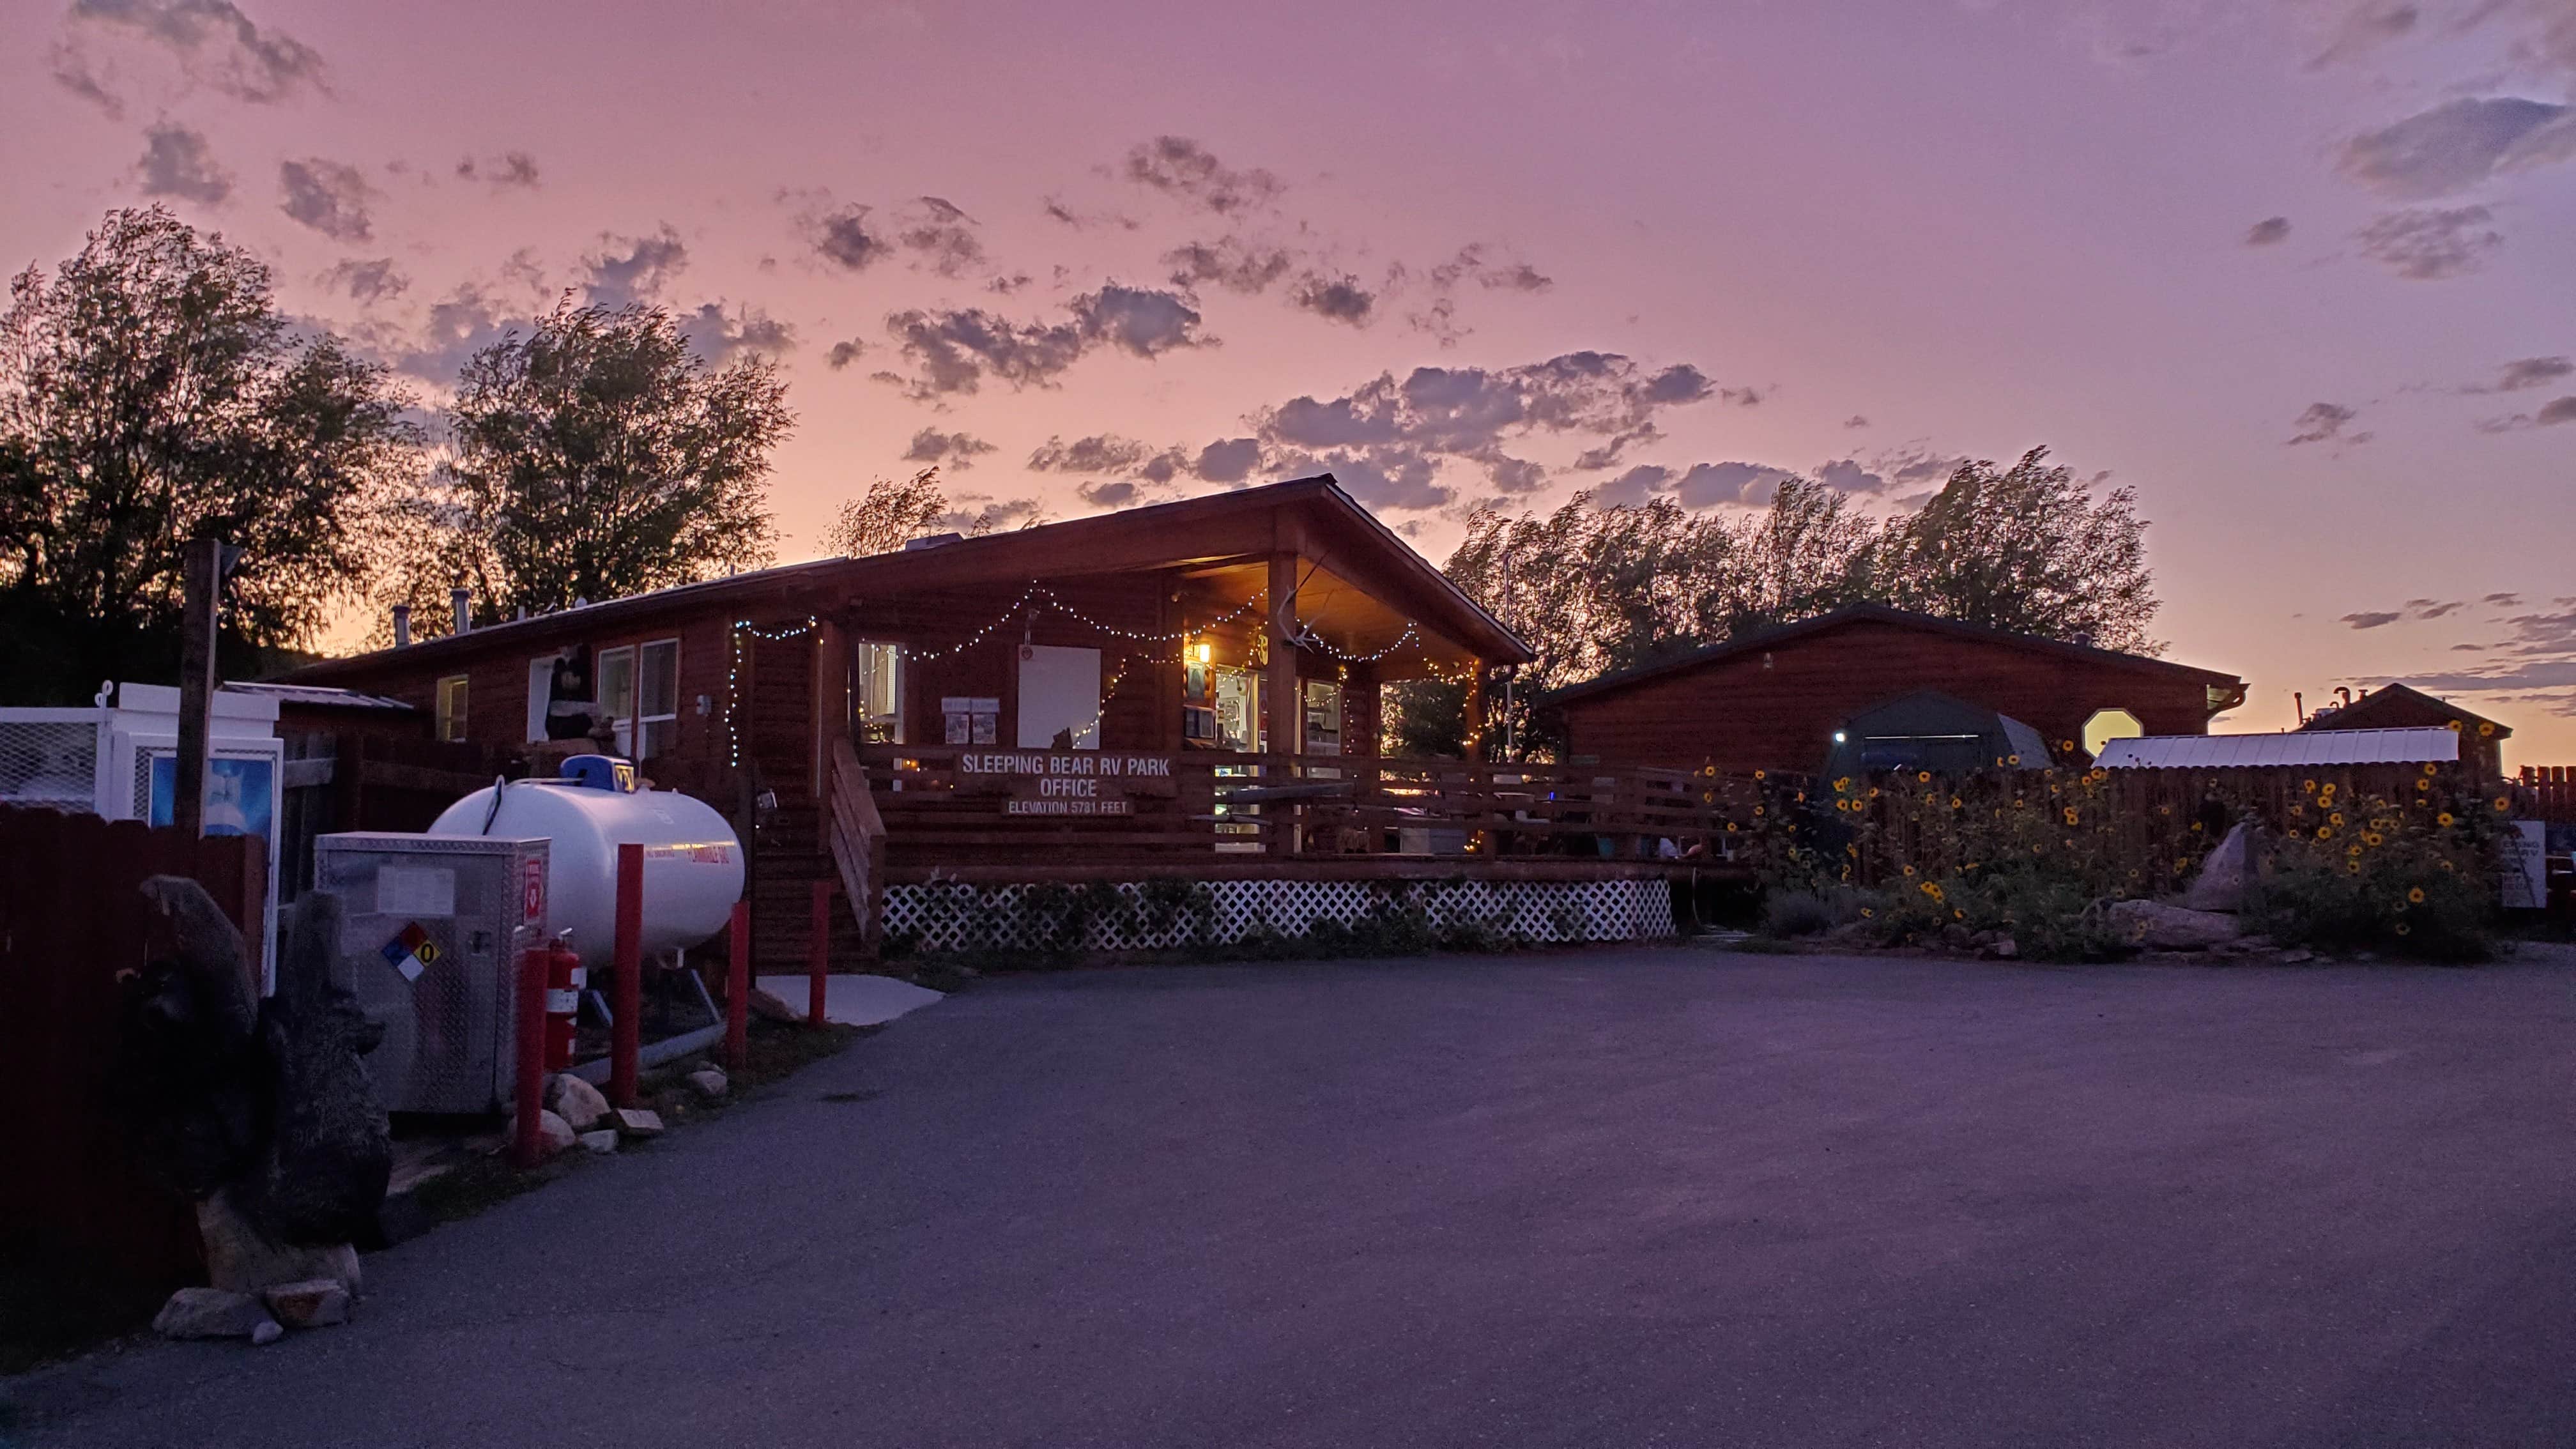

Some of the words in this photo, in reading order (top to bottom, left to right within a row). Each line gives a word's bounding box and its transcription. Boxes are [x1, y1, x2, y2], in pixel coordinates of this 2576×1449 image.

[963, 754, 1043, 774] SLEEPING
[1050, 756, 1093, 774] BEAR
[1100, 758, 1121, 775] RV
[1128, 758, 1170, 776] PARK
[1040, 779, 1097, 797] OFFICE
[1008, 801, 1067, 813] ELEVATION
[1101, 802, 1127, 813] FEET
[420, 943, 434, 963] 0
